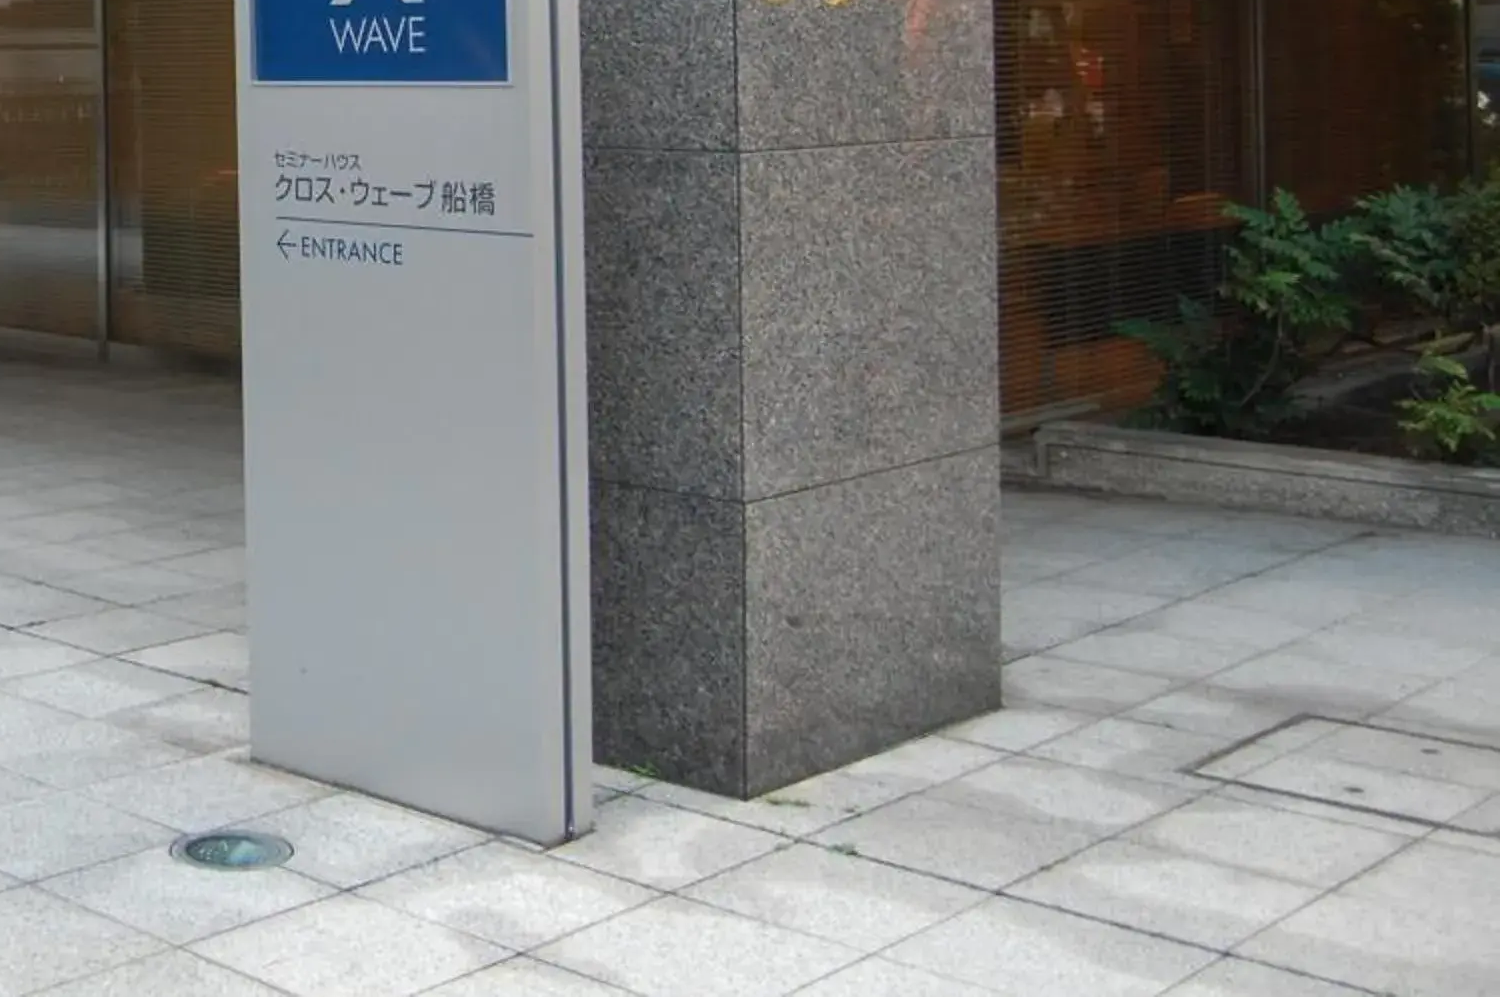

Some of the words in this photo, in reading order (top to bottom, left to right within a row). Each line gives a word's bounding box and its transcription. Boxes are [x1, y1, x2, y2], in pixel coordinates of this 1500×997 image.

[330, 16, 426, 53] WAVE
[275, 150, 362, 171] セミナーハウス
[301, 236, 404, 265] ENTRANCE
